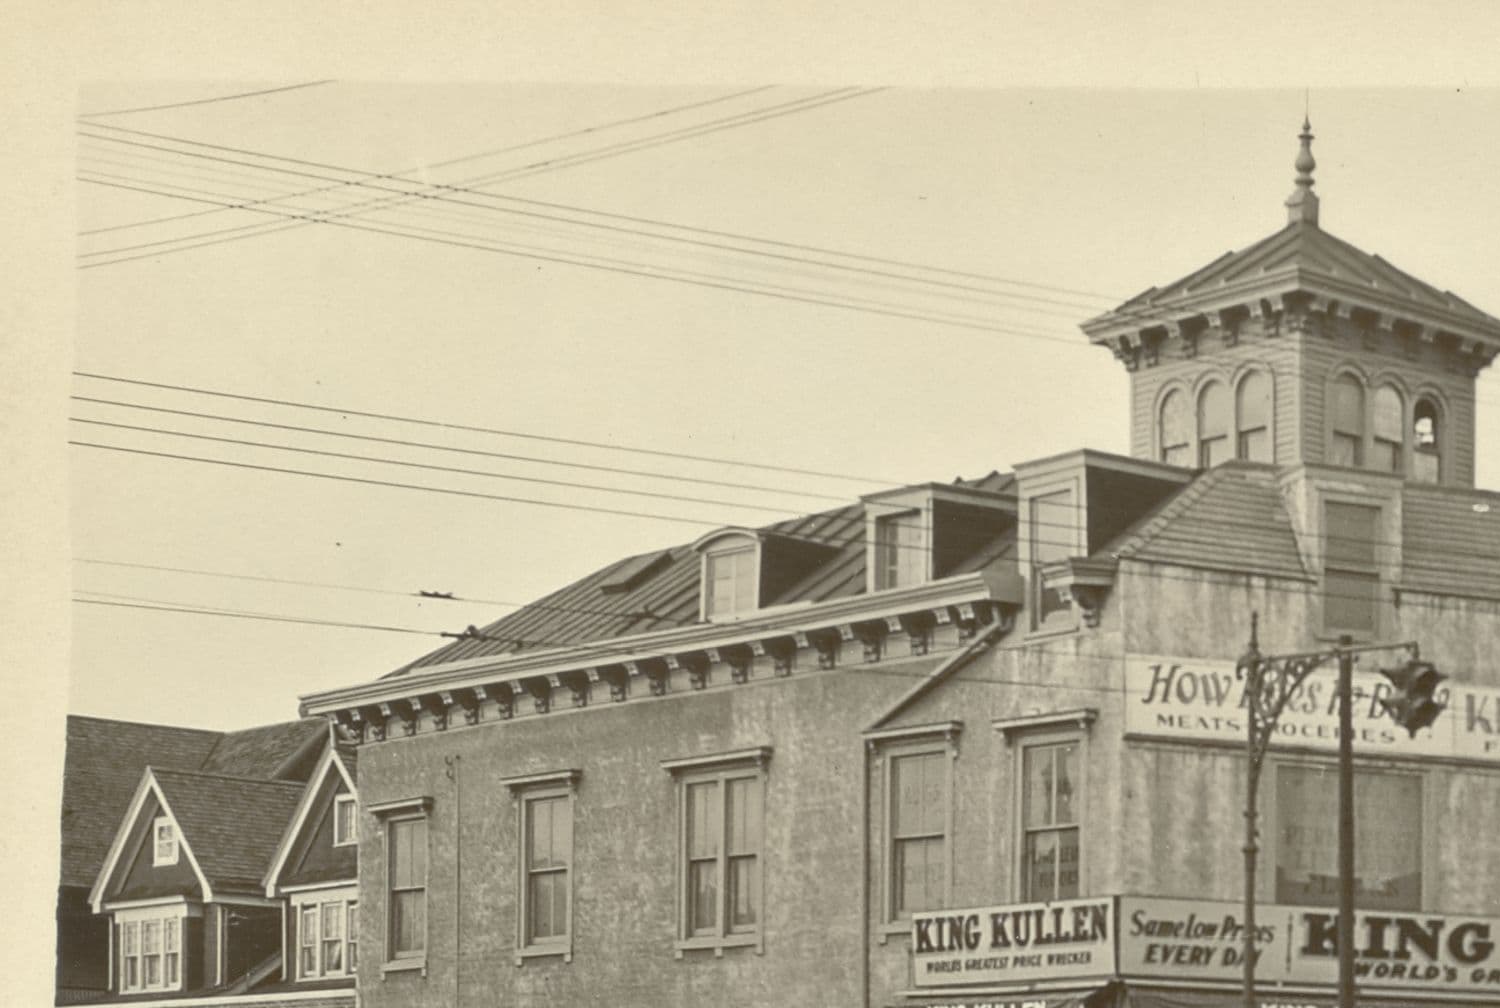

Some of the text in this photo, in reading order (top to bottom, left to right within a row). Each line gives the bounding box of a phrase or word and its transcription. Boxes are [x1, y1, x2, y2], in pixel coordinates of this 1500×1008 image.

[1141, 662, 1232, 707] How
[1156, 713, 1241, 732] MEATS
[914, 903, 1109, 954] KING KULLEN
[1129, 909, 1184, 938] Same
[1301, 911, 1495, 965] KING
[1143, 943, 1217, 967] EVERY
[1354, 961, 1458, 983] WORLD'S
